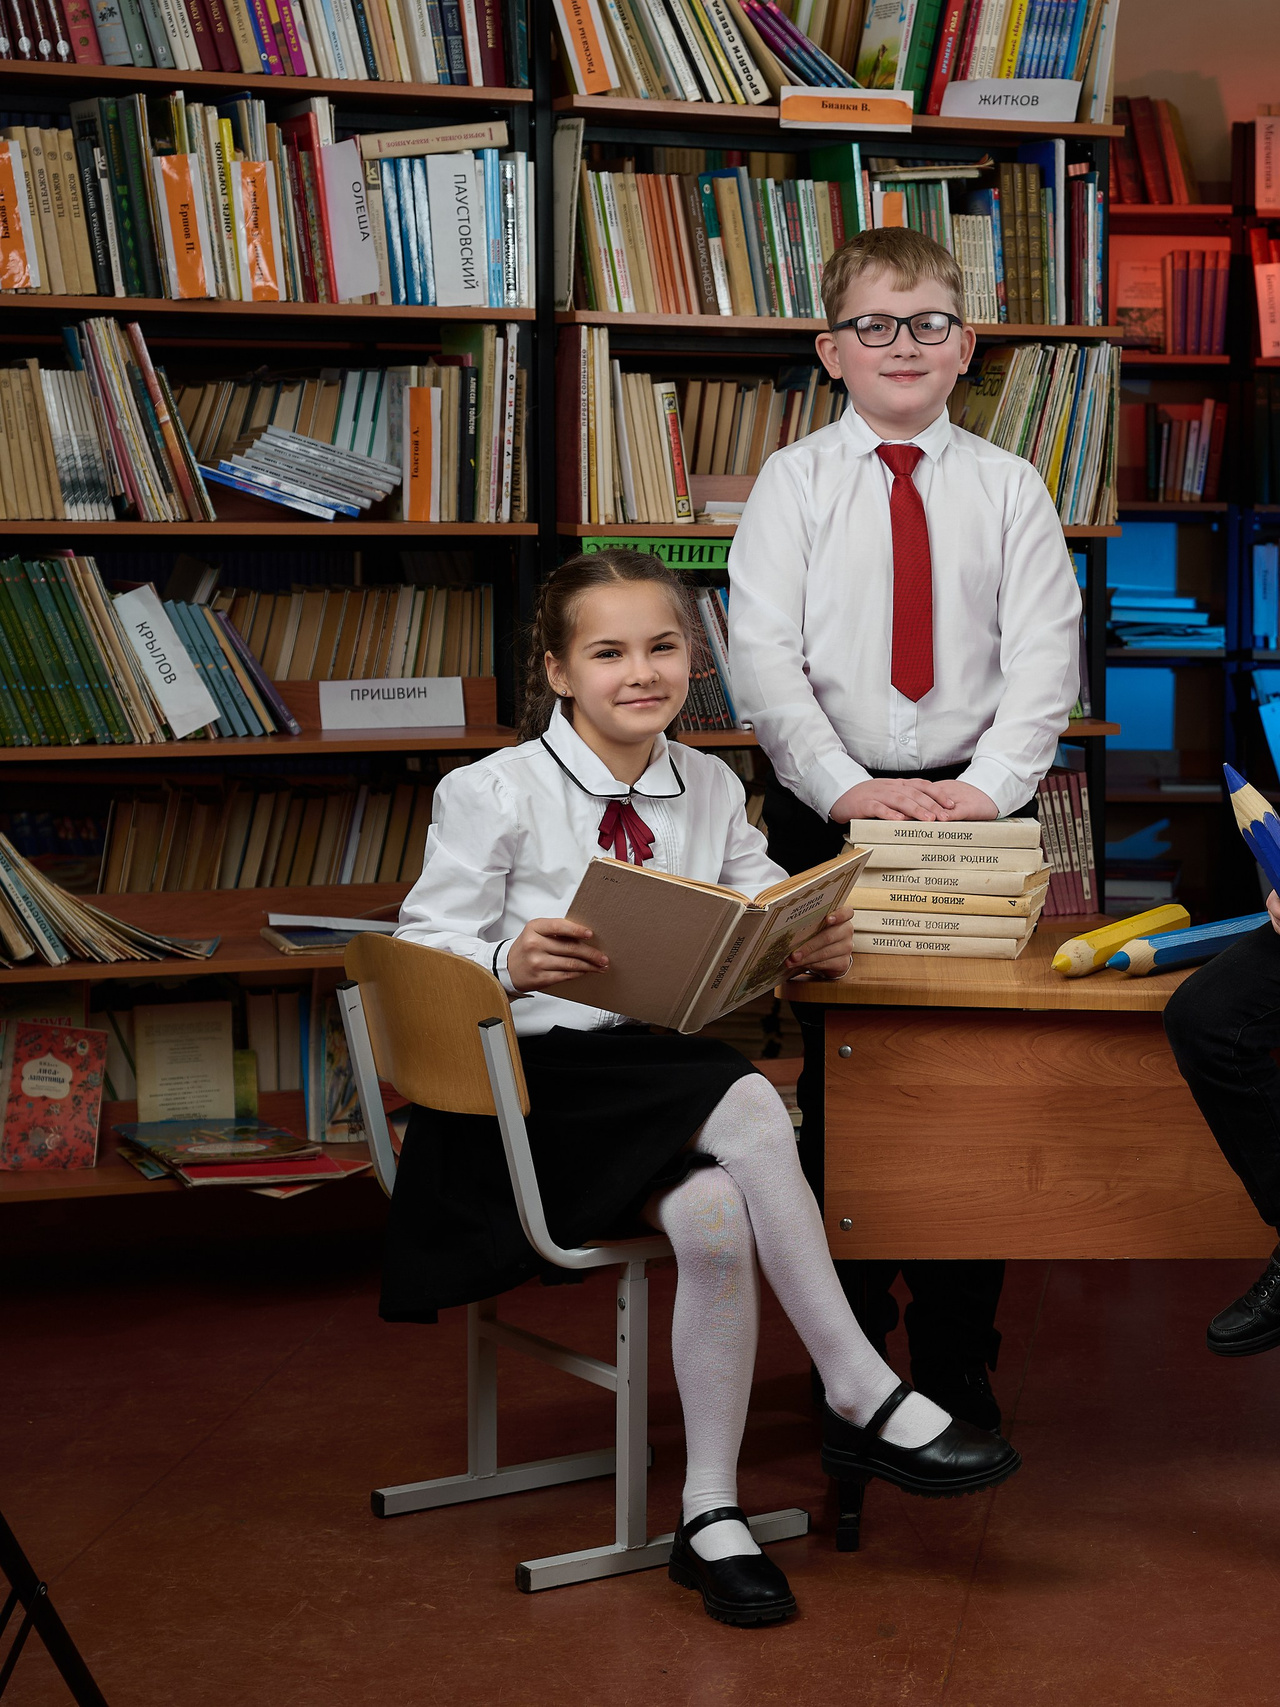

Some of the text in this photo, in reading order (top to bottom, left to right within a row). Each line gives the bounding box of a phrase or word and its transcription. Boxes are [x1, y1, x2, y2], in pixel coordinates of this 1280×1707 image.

[281, 5, 299, 51] СКАЗКИ
[941, 9, 959, 72] ВРЕМЕНА ГОДА
[575, 26, 594, 74] Рассказы
[709, 0, 759, 97] БРОДЯГИ СЕВЕРА
[821, 100, 870, 113] Бианки В.
[978, 93, 1040, 108] ЖИТКОВ
[385, 130, 485, 148] ЮРИЙ ОЛЕША ИЗБРАННОЕ
[1263, 122, 1274, 190] Математика
[34, 168, 49, 198] БАЖОВ
[48, 172, 64, 201] БАЖОВ
[64, 173, 80, 201] БАЖОВ
[351, 181, 371, 243] ОЛЕША
[176, 201, 195, 255] Ершов П.
[453, 173, 479, 291] ПАУСТОВСКИЙ
[695, 226, 712, 296] СЕТОН-ТОМПСОН
[1266, 273, 1277, 325] Биология
[410, 426, 419, 479] Толстой А.
[649, 542, 731, 564] КНИГ
[135, 621, 178, 686] КРЫЛОВ
[349, 685, 428, 701] ПРИШВИН
[894, 829, 973, 840] ЖИВОЙ РОДНИК
[921, 854, 999, 864] ЖИВОЙ РОДНИК
[882, 874, 959, 886] ЖИВОЙ РОДНИК
[890, 893, 965, 905] ЖИВОЙ РОДНИК
[1008, 899, 1018, 907] 4
[882, 918, 960, 930] ЖИВОЙ РОДНИК
[873, 938, 950, 951] ЖИВОЙ РОДНИК
[711, 936, 745, 990] ЖИВОЙ РОДНИК
